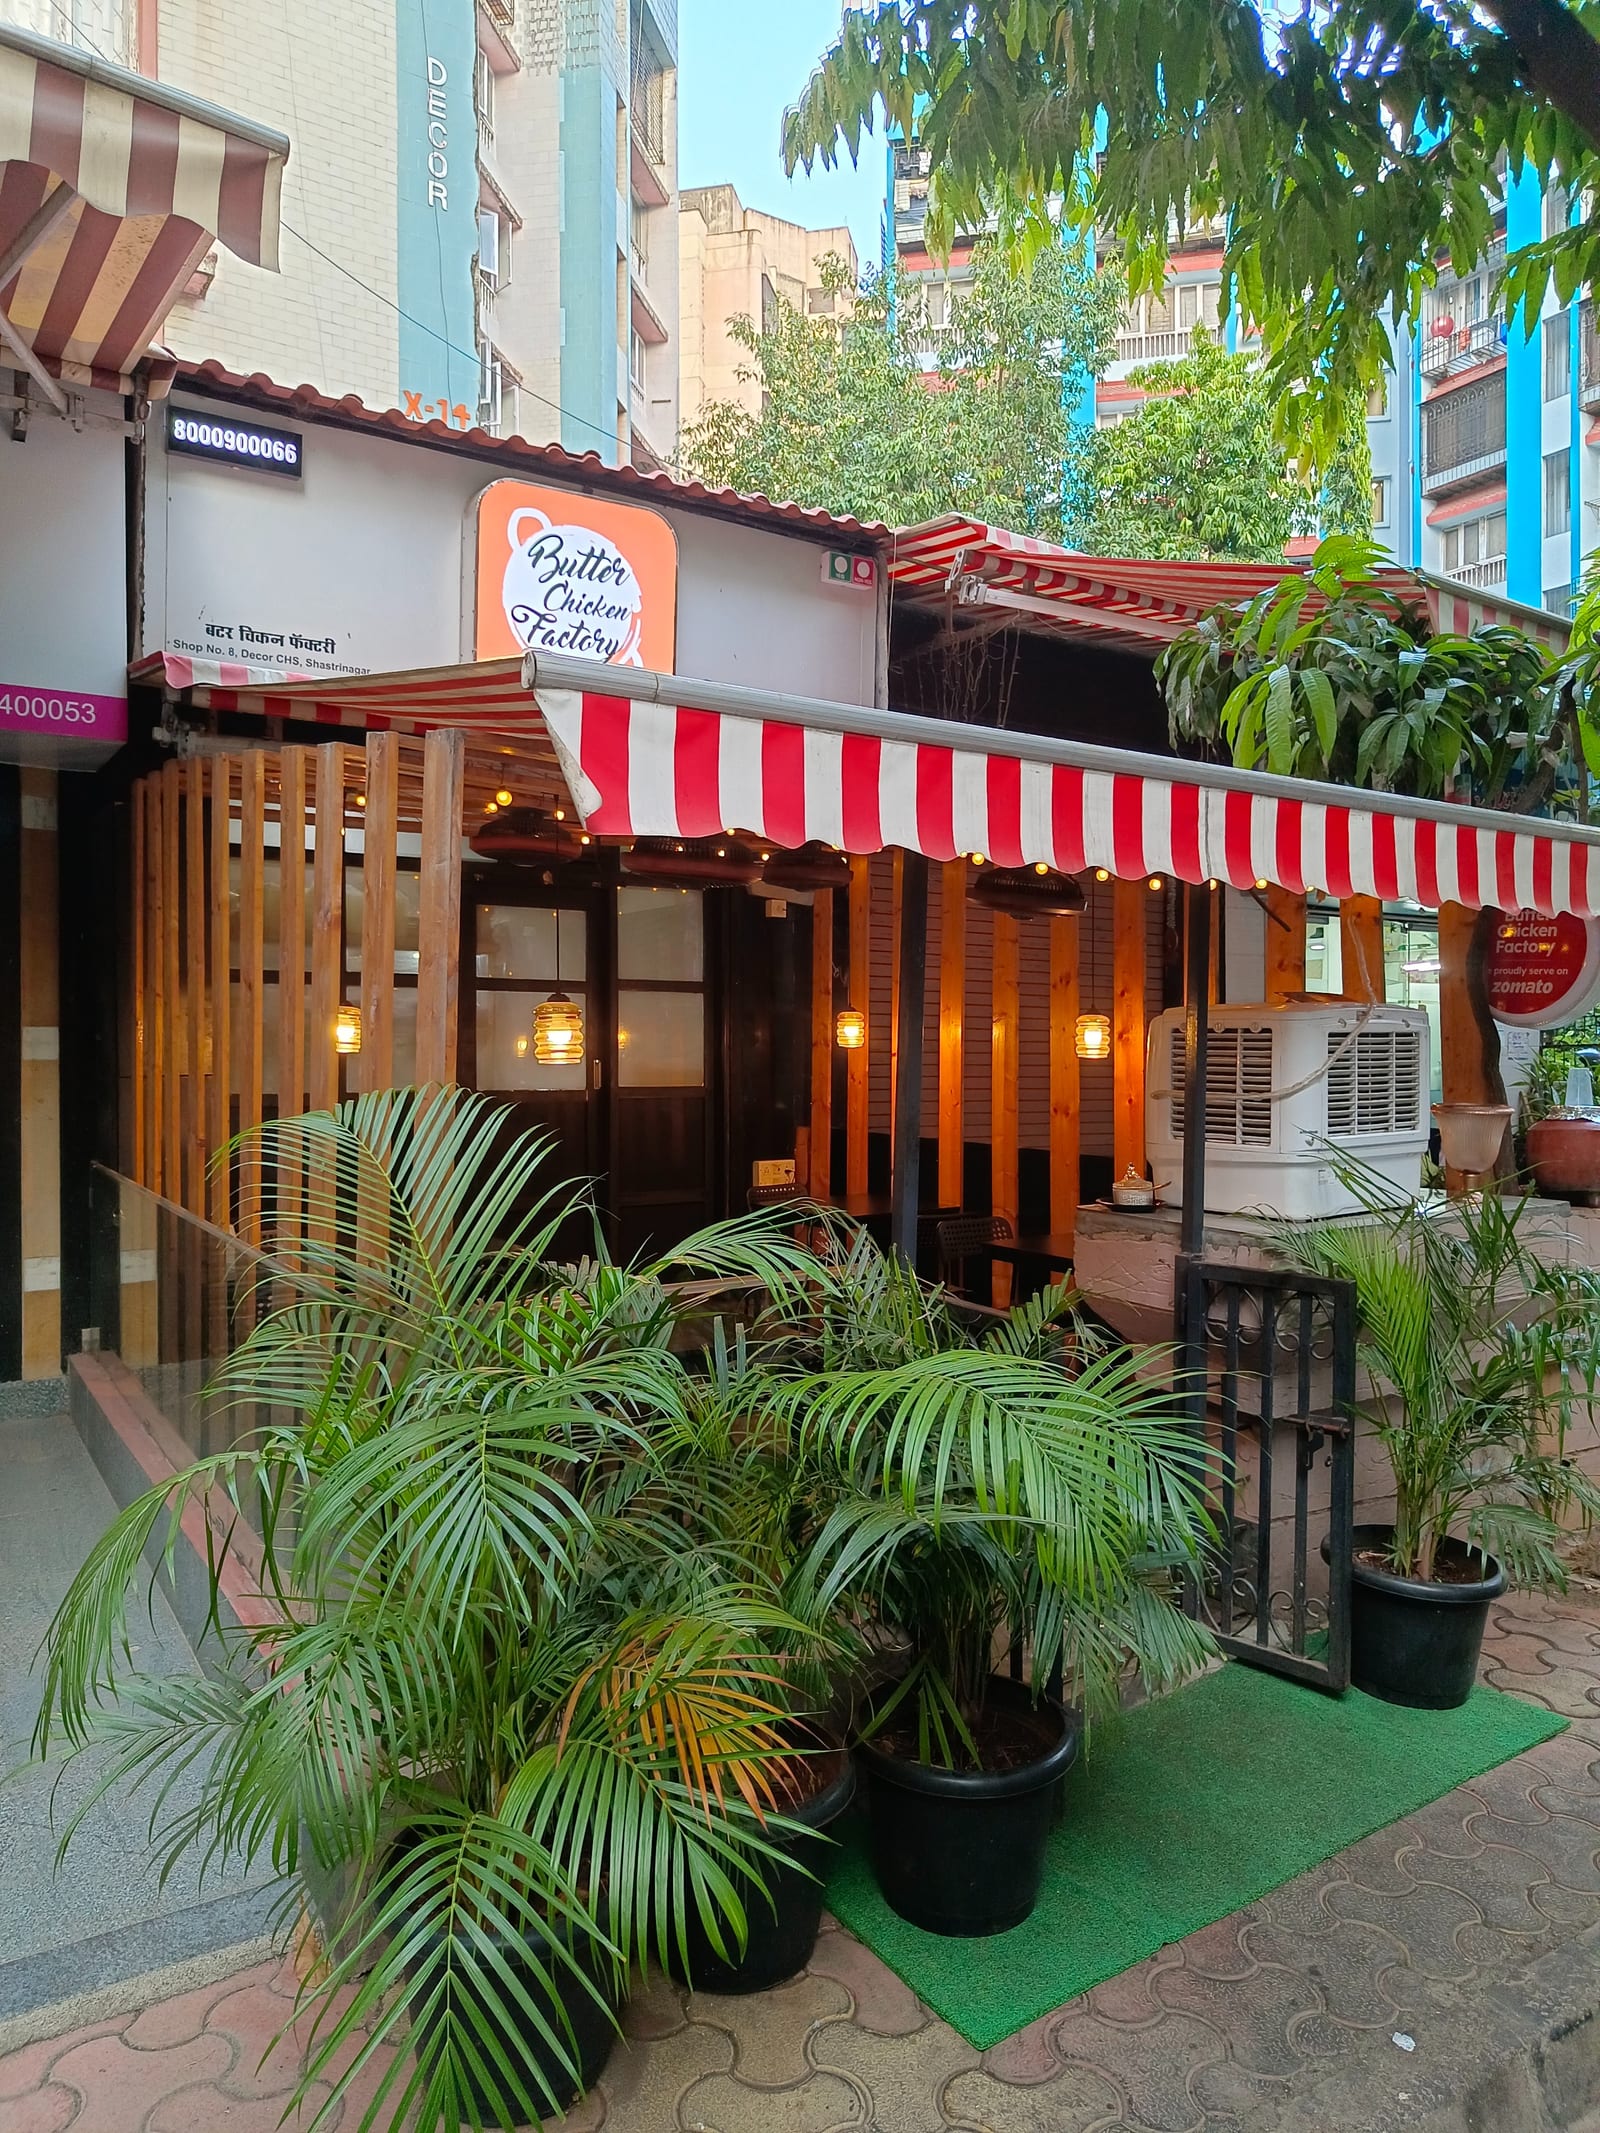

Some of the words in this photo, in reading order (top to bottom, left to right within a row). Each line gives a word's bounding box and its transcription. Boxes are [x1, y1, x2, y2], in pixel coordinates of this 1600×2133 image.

[427, 56, 448, 211] DECOR
[403, 390, 471, 430] X-14
[173, 418, 298, 464] 8000900066
[528, 534, 631, 586] Butter
[543, 580, 632, 621] Chicken
[205, 623, 234, 640] बटर
[239, 625, 285, 647] चिकन
[511, 604, 622, 664] Factory
[173, 639, 203, 654] Shop
[205, 644, 225, 656] No.
[228, 647, 238, 659] 8,
[241, 649, 274, 663] Decor
[276, 654, 303, 668] CHS,
[305, 658, 371, 676] Shastrinagar
[0, 693, 97, 724] 400053
[1504, 909, 1549, 922] Butte
[1491, 979, 1553, 994] zomato
[1493, 966, 1527, 977] proudly
[1528, 967, 1554, 976] serve
[1556, 968, 1568, 976] on
